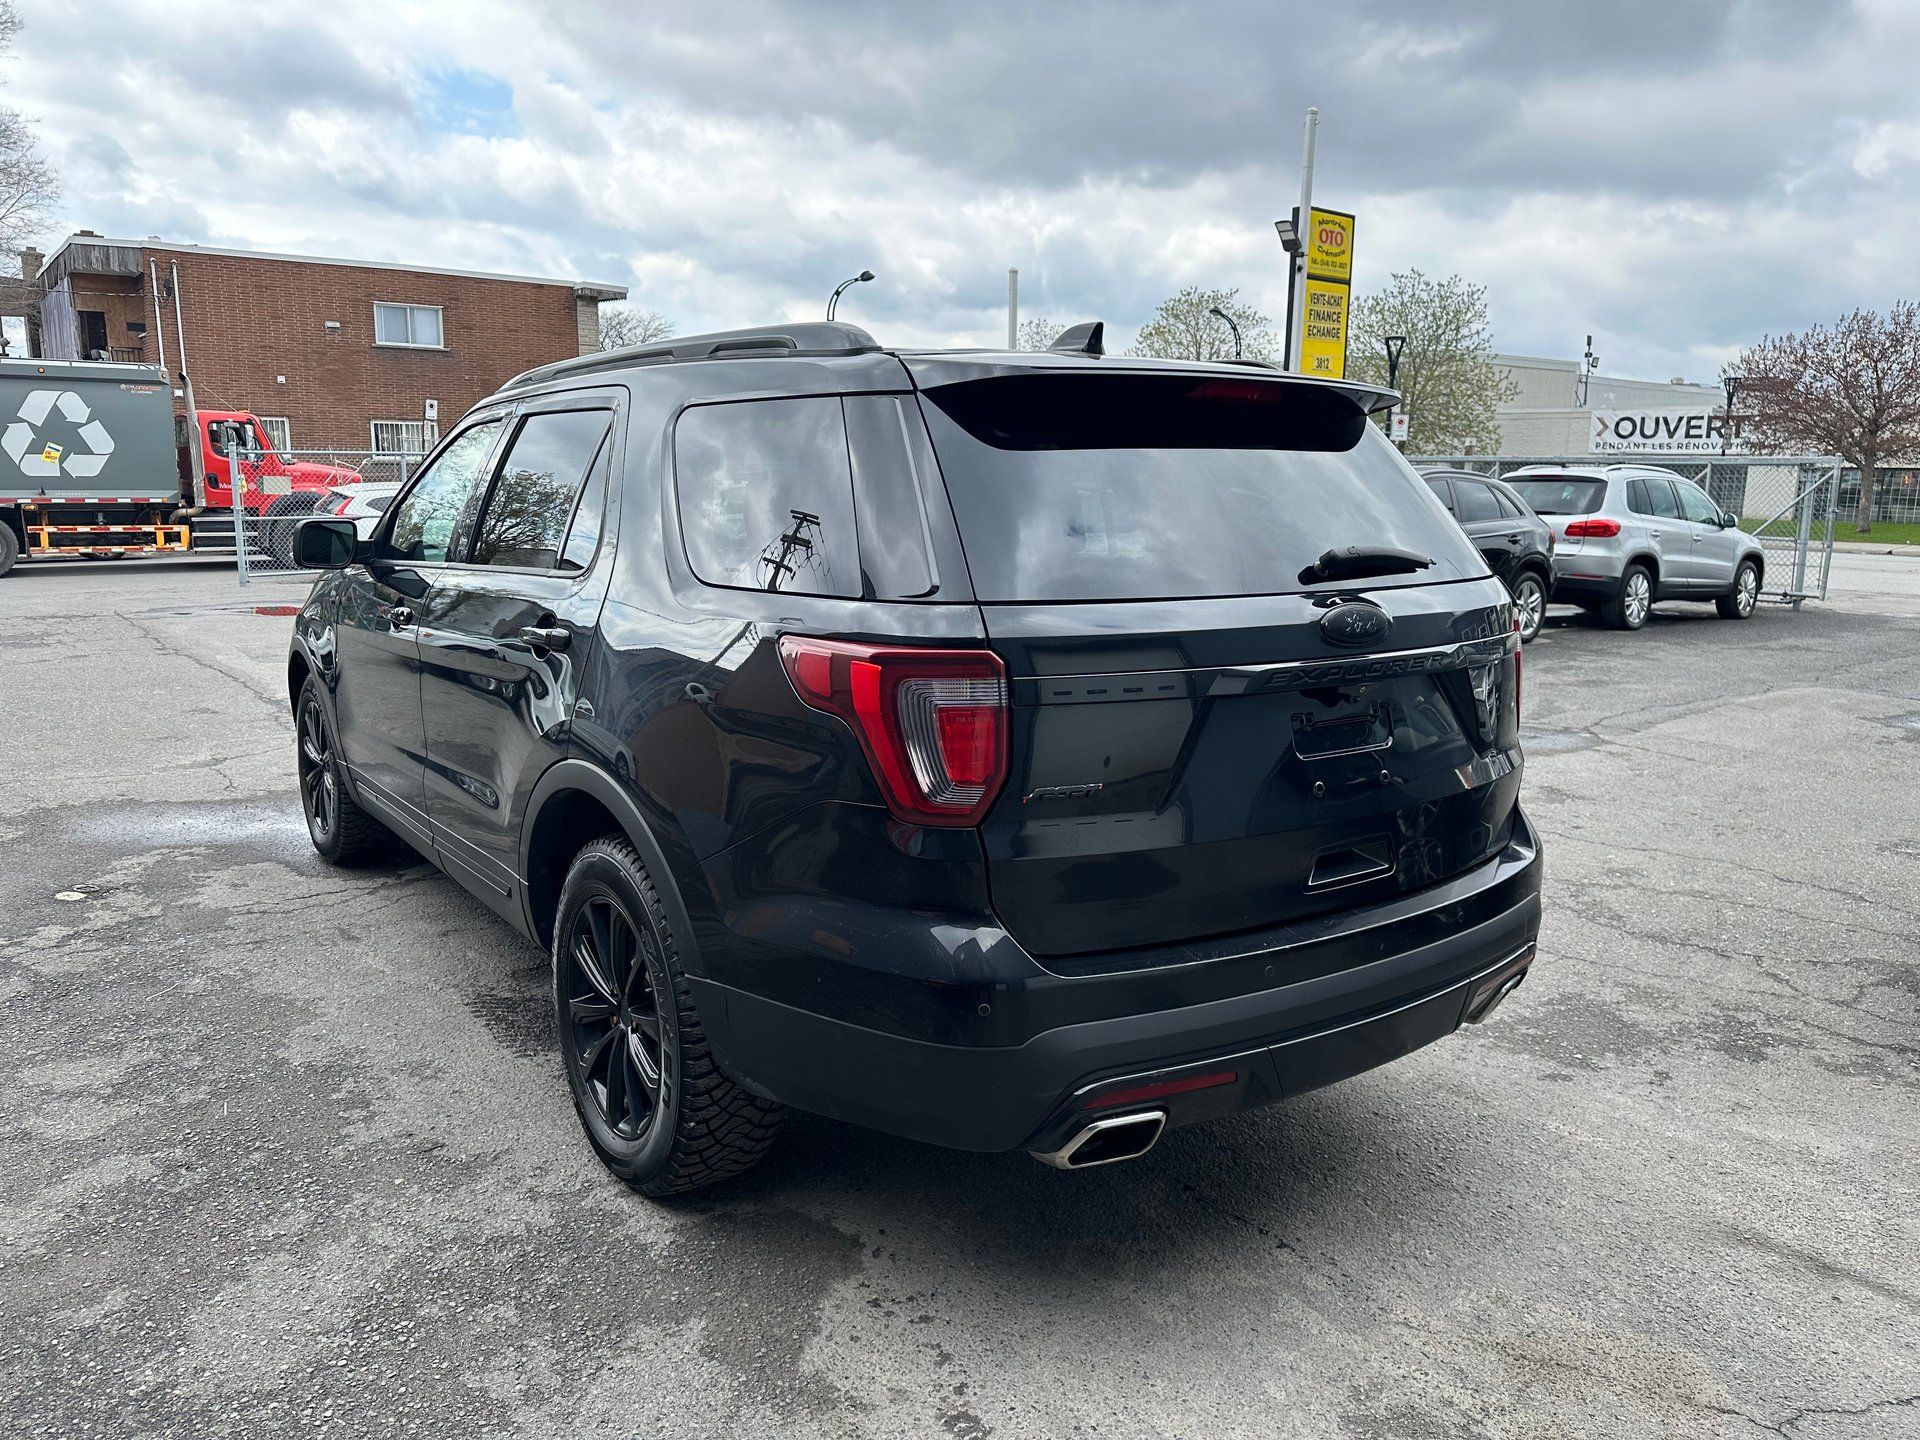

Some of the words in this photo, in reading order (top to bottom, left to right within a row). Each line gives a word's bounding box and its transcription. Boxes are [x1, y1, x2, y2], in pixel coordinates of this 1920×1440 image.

[1318, 218, 1347, 233] Montréal
[1319, 228, 1344, 247] OTO
[1309, 292, 1343, 307] VENTE-ACHAT
[1308, 308, 1342, 323] FINANCE
[1307, 325, 1341, 339] ECHANGE
[1315, 356, 1330, 370] 3812
[1595, 441, 1648, 451] PENDANT
[1651, 442, 1672, 451] LES
[1264, 653, 1445, 687] EXPLORER
